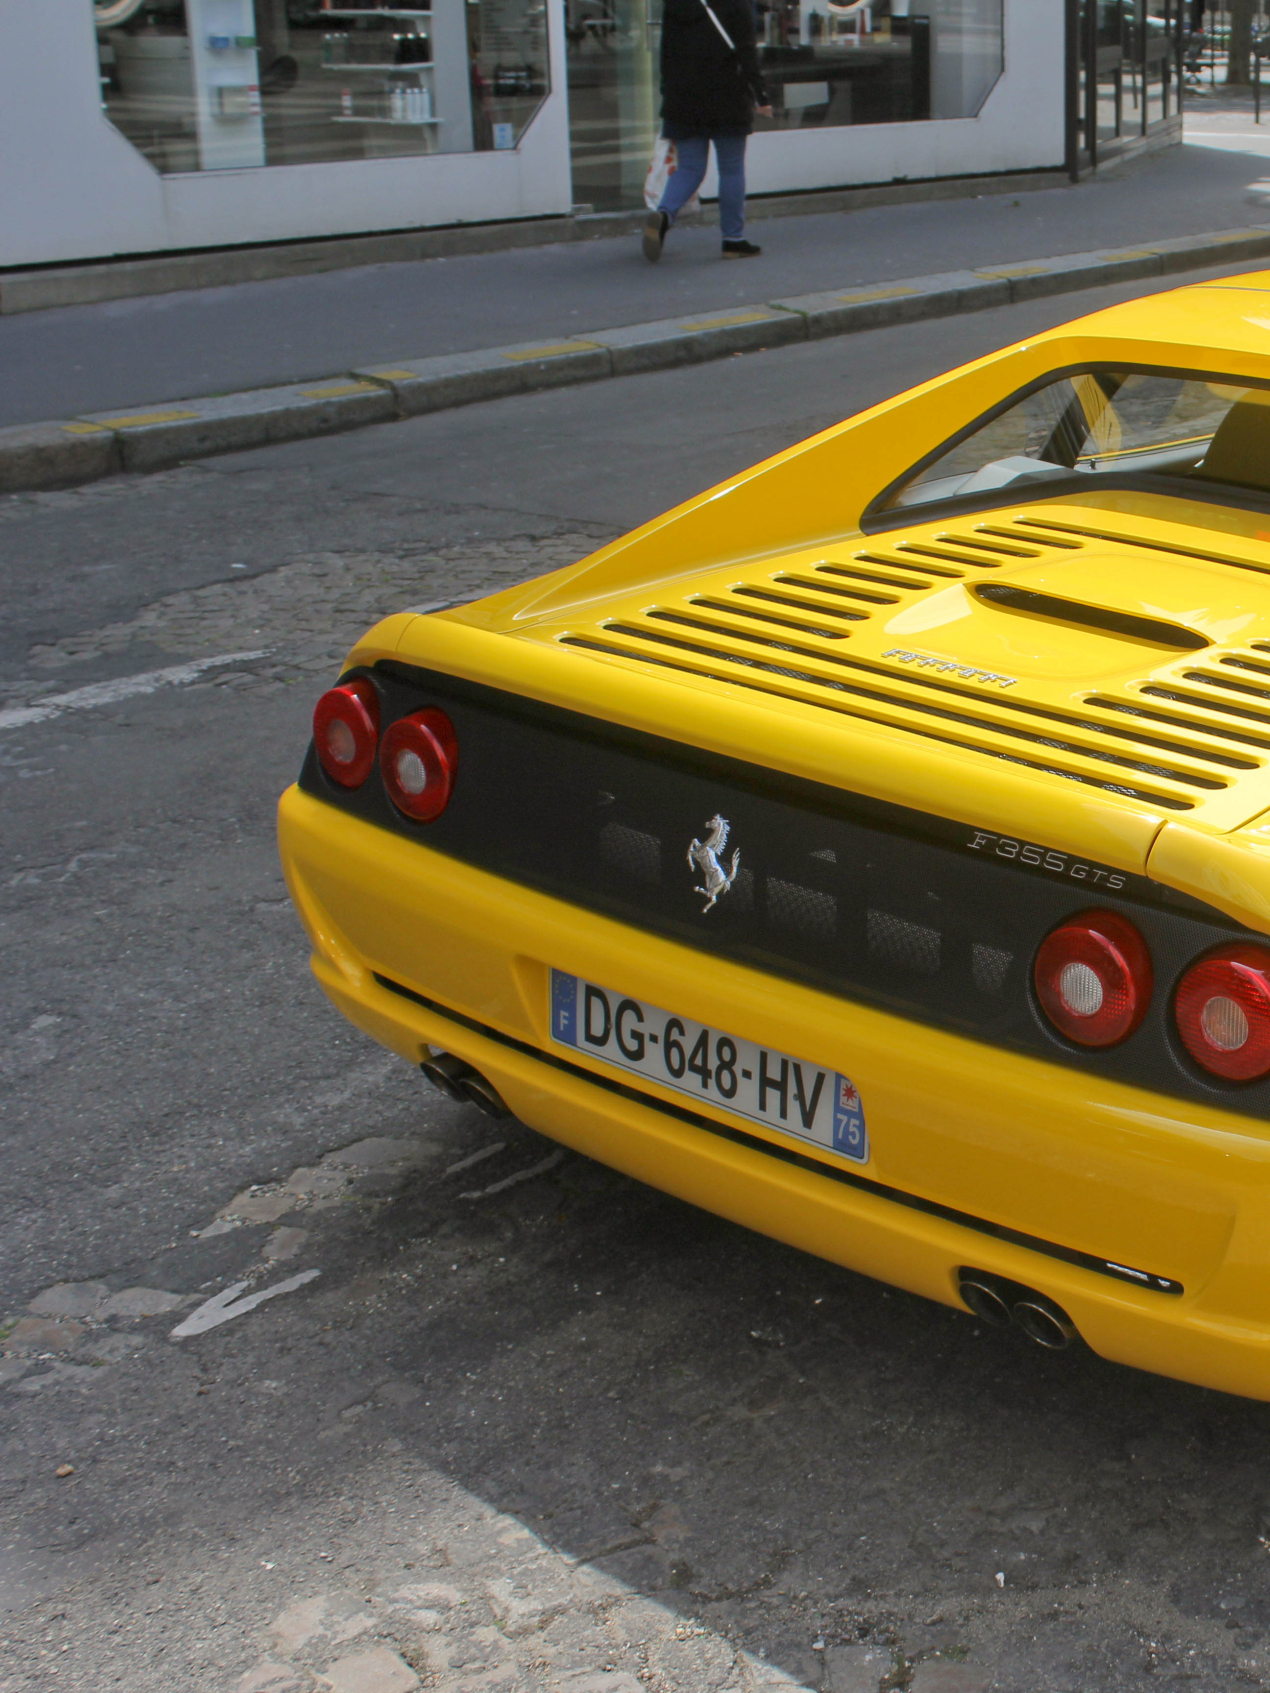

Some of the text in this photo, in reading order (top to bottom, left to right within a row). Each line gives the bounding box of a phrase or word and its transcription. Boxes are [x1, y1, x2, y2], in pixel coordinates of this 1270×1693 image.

[881, 648, 1018, 688] Ferrari
[967, 831, 1126, 889] F355 GTS
[559, 1010, 569, 1031] F
[584, 983, 826, 1130] DG-648-HV
[836, 1113, 860, 1145] 75
